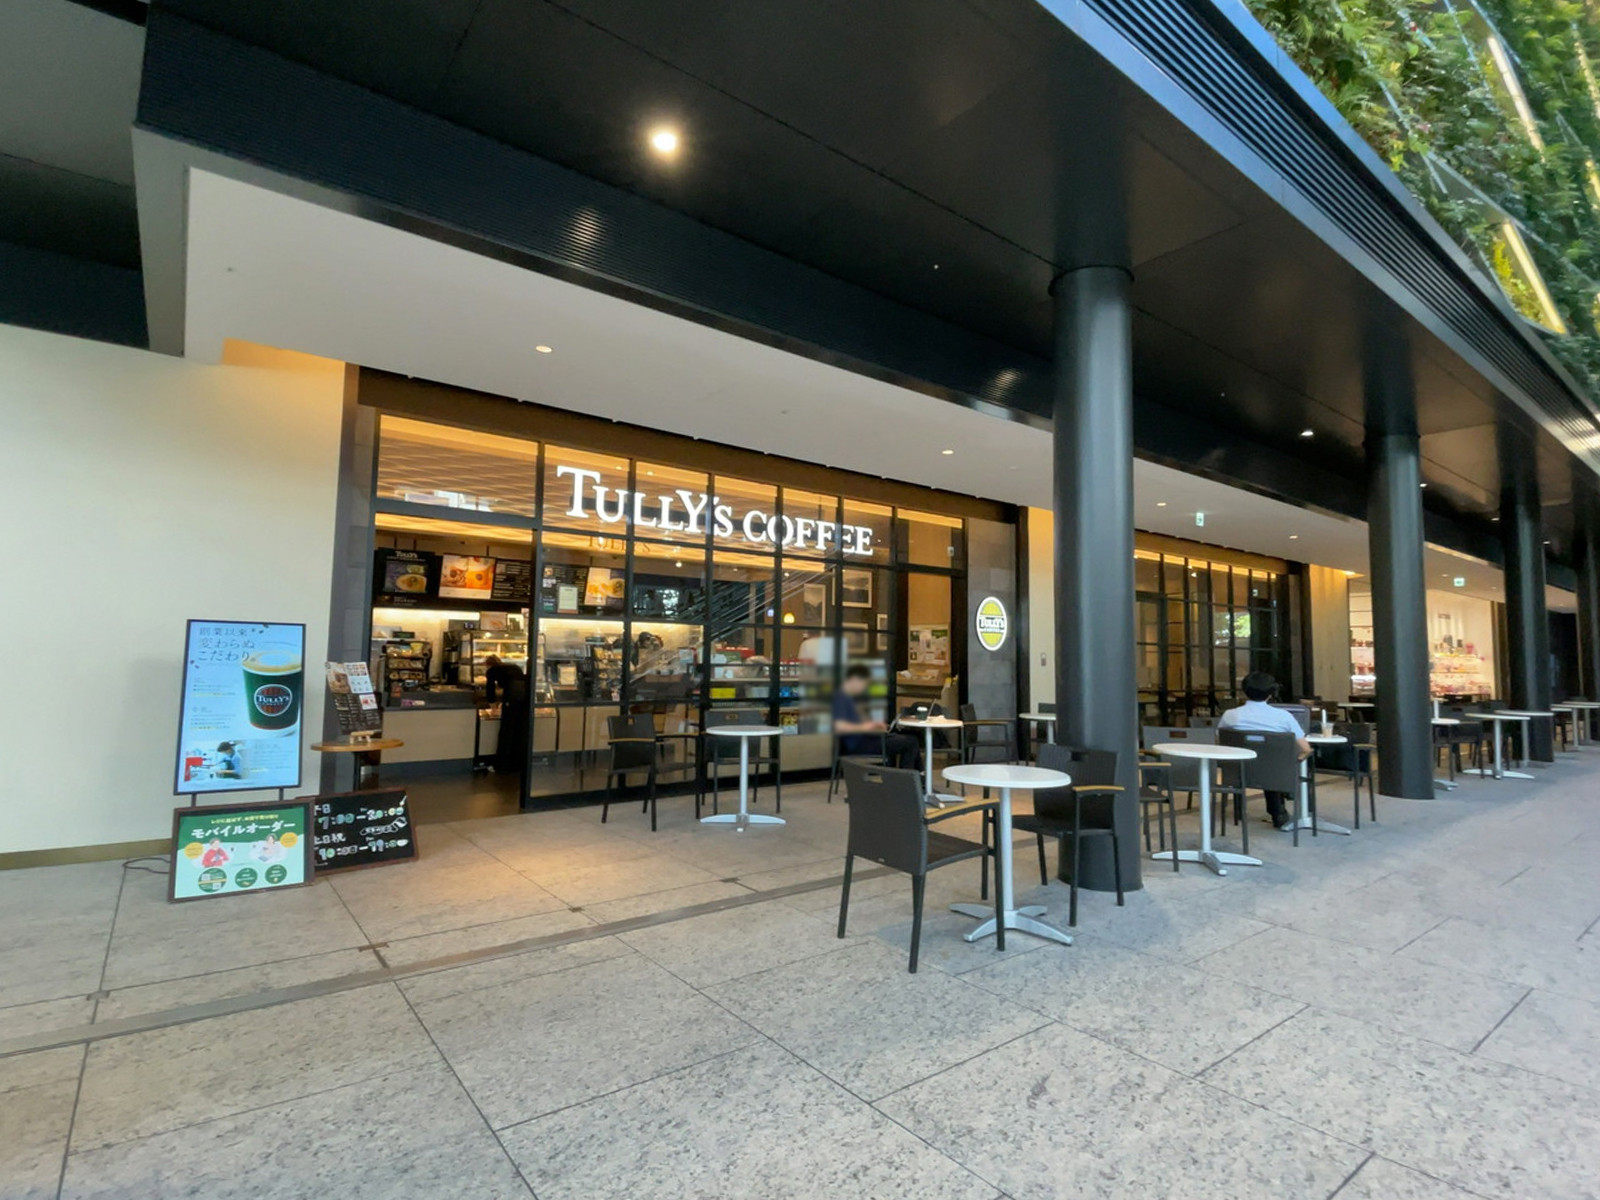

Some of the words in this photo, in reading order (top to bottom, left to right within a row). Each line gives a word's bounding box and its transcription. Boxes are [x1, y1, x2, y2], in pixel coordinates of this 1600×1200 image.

[557, 466, 733, 537] TULLY'S
[743, 510, 873, 556] COFFEE
[191, 820, 296, 838] モバイルオーダー
